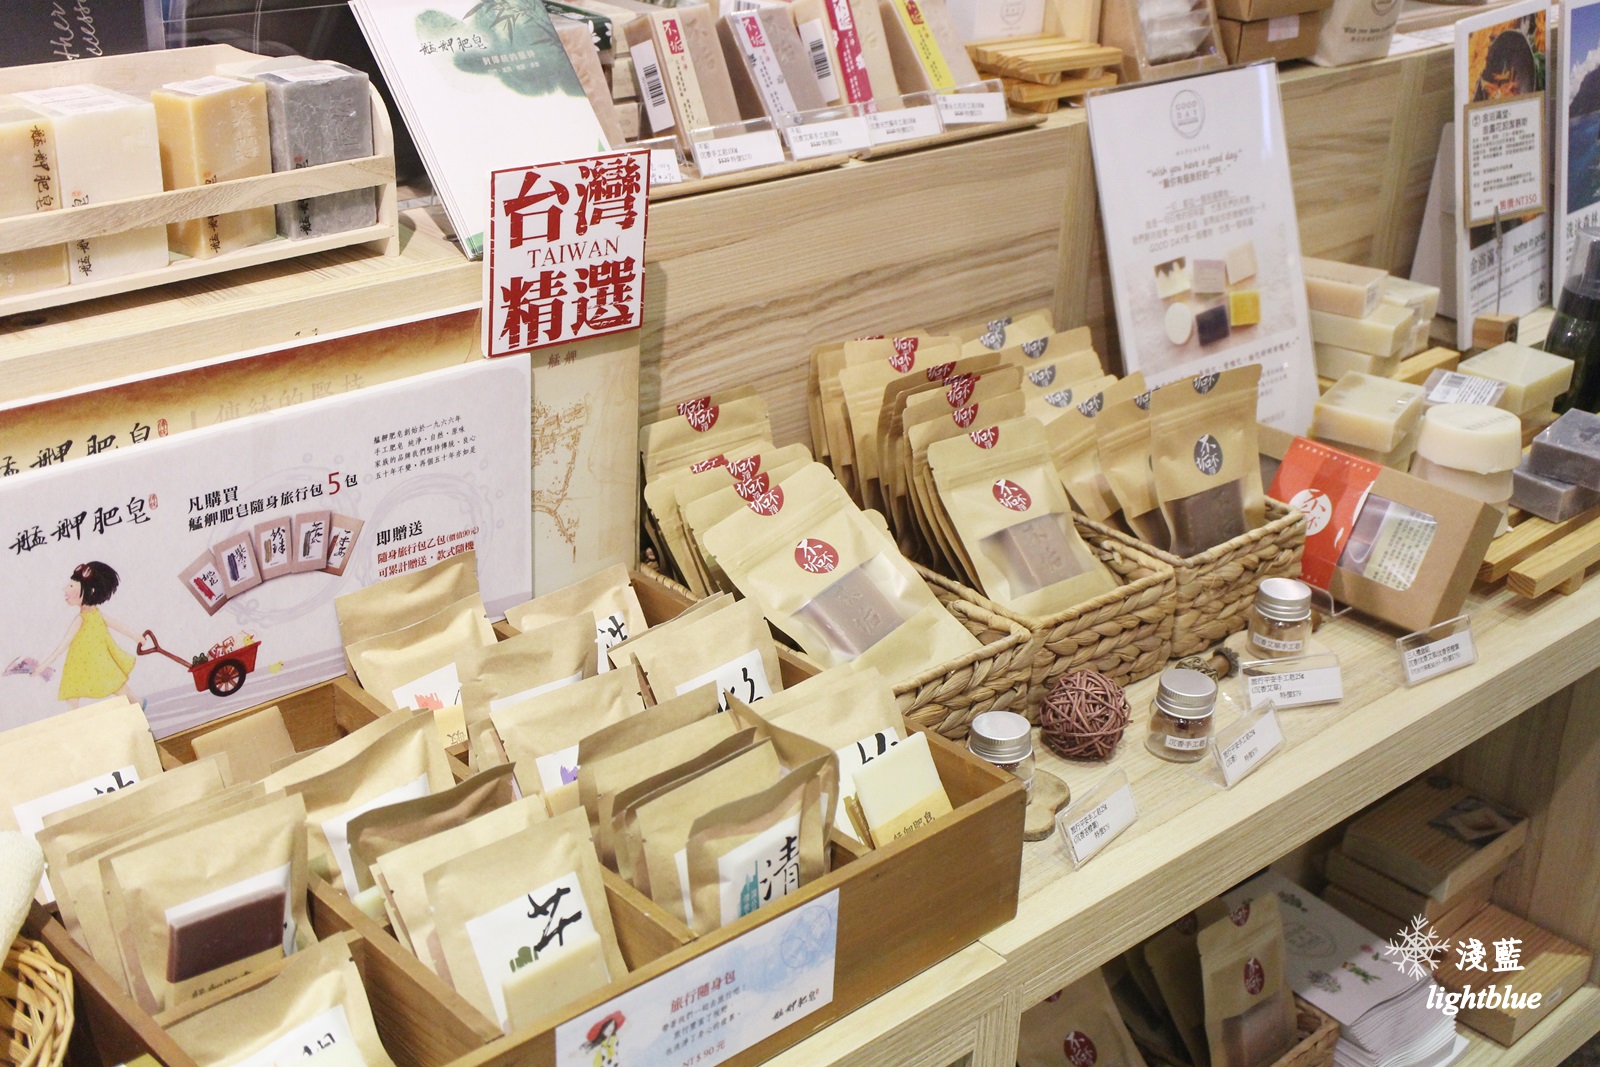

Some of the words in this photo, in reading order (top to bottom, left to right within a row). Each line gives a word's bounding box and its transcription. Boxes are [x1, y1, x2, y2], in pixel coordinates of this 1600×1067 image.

[419, 34, 488, 56] 艋舺肥皂
[503, 157, 642, 249] 台灣
[527, 235, 621, 269] TAIWAN
[498, 256, 637, 350] 精選
[373, 414, 462, 445] 艋舺肥皂創始於一九六六年
[187, 485, 240, 515] 凡購買
[9, 496, 152, 556] 艋舺肥皂
[376, 519, 423, 547] 即贈送
[1168, 738, 1206, 750] 沉香手工皂
[670, 969, 737, 1014] 旅行隨身包
